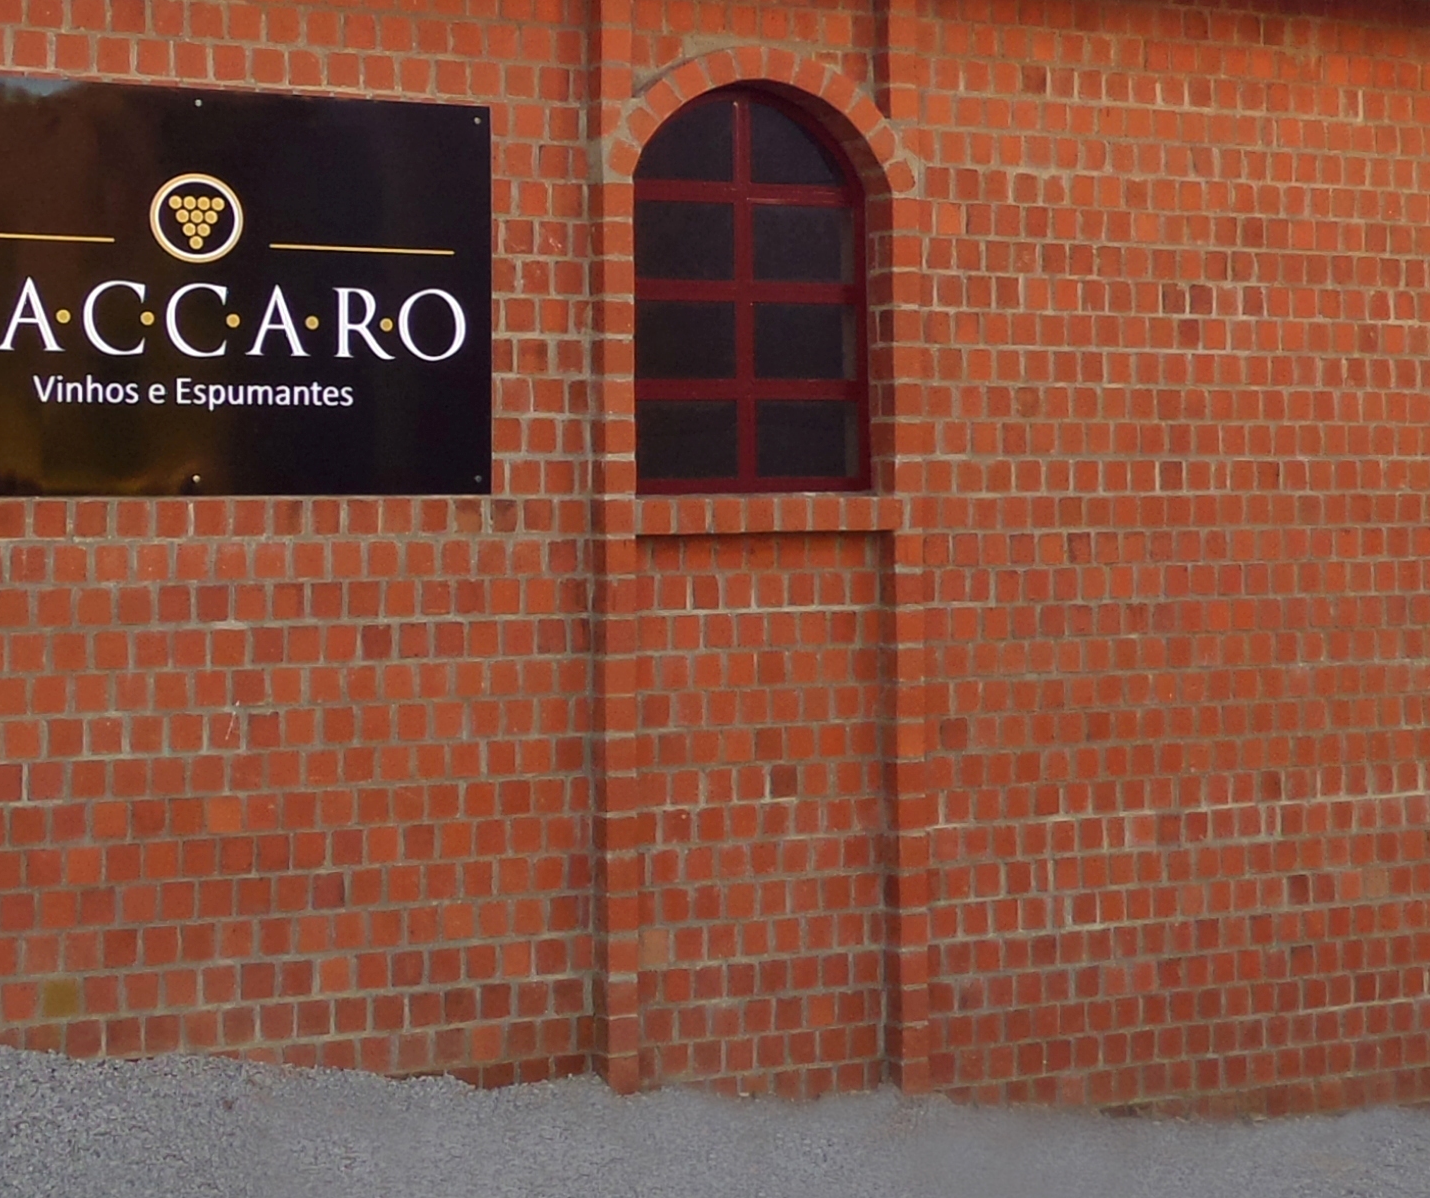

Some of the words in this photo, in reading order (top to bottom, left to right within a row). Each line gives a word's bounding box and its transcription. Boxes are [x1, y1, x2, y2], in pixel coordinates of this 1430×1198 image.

[32, 373, 140, 405] Vinhos
[147, 382, 167, 405] e
[175, 376, 355, 413] Espumantes
